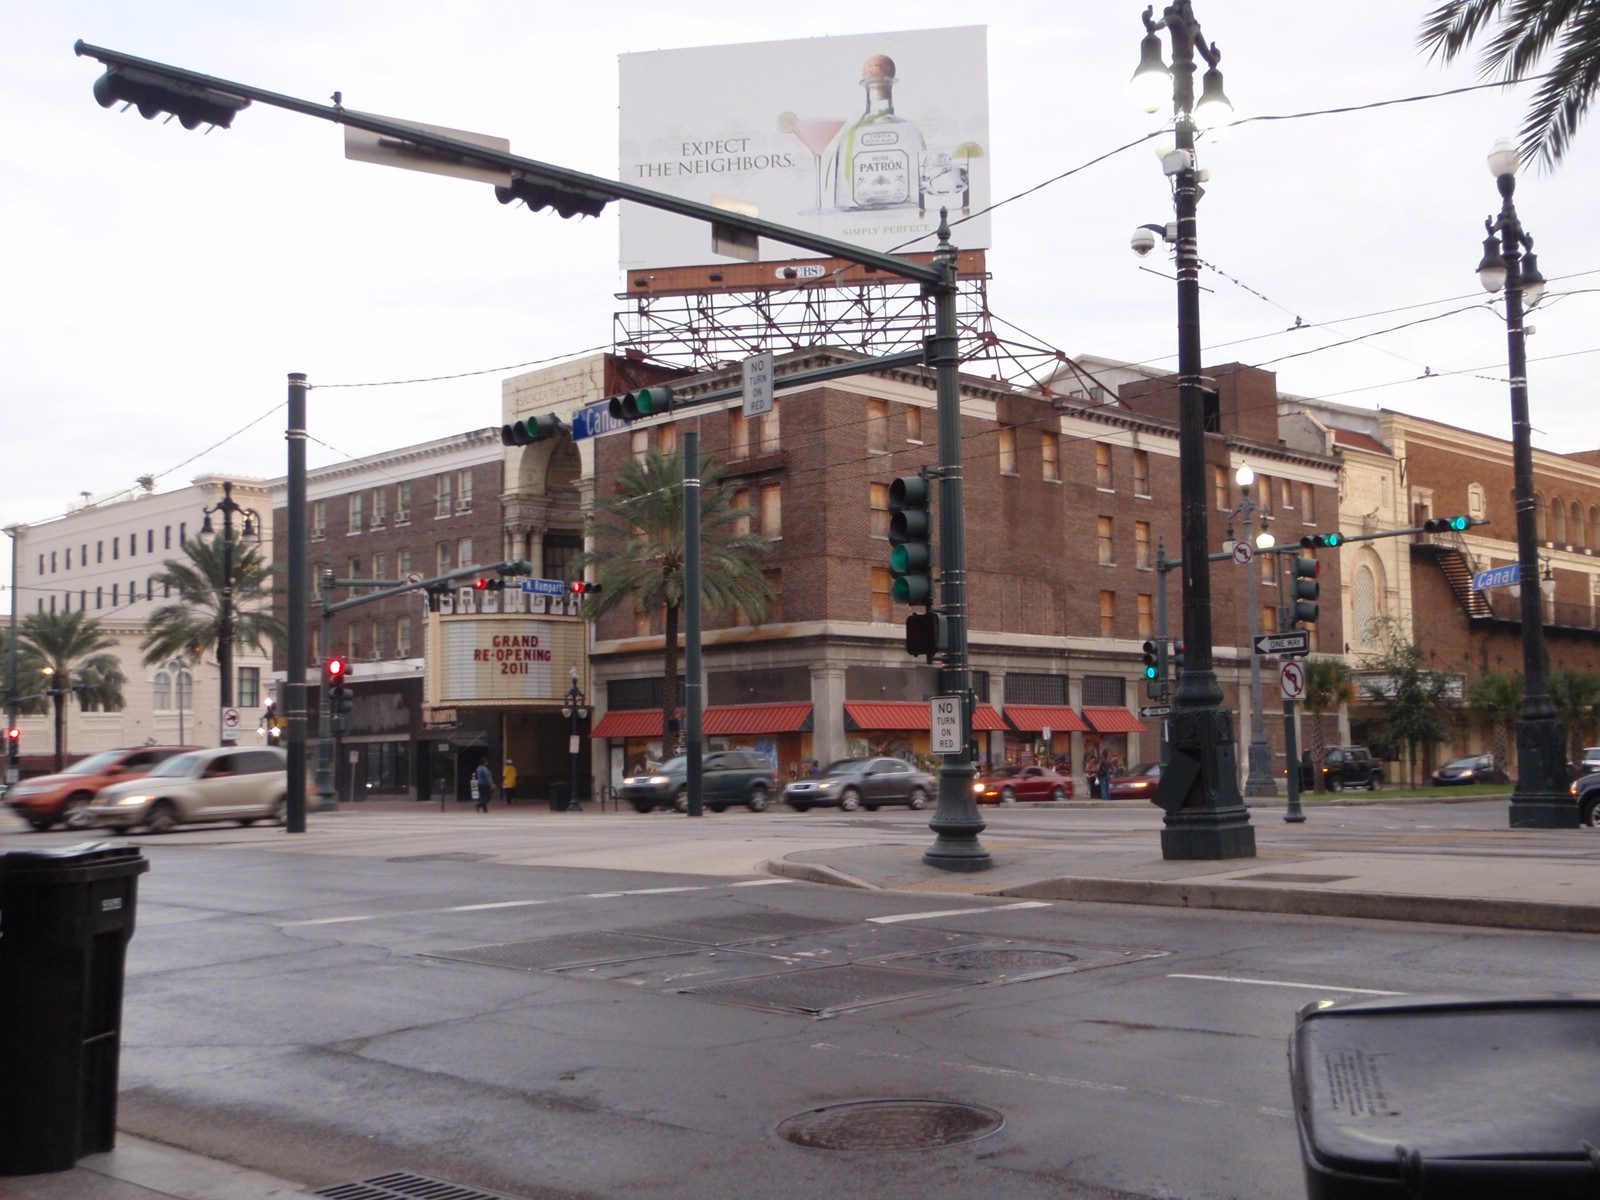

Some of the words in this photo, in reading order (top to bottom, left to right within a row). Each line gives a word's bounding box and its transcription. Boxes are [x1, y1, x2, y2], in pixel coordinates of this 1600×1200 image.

[681, 138, 751, 157] EXPECT
[635, 162, 672, 178] THE
[678, 153, 796, 175] NEIGHBORS.
[842, 227, 879, 237] SIMPLY
[796, 266, 818, 277] CBS
[751, 360, 765, 373] NO
[750, 374, 767, 386] TURN
[753, 387, 762, 398] ON
[751, 399, 765, 411] RED
[1477, 566, 1516, 588] Canal
[534, 580, 562, 593] Rampart
[492, 635, 539, 648] GRAND
[1270, 640, 1285, 648] ONE
[1287, 638, 1301, 646] WAY
[474, 649, 552, 662] RE-OPENING
[501, 662, 529, 675] 2011
[938, 703, 953, 714] NO
[937, 716, 956, 726] TURN
[942, 728, 952, 737] ON
[940, 740, 954, 748] RED
